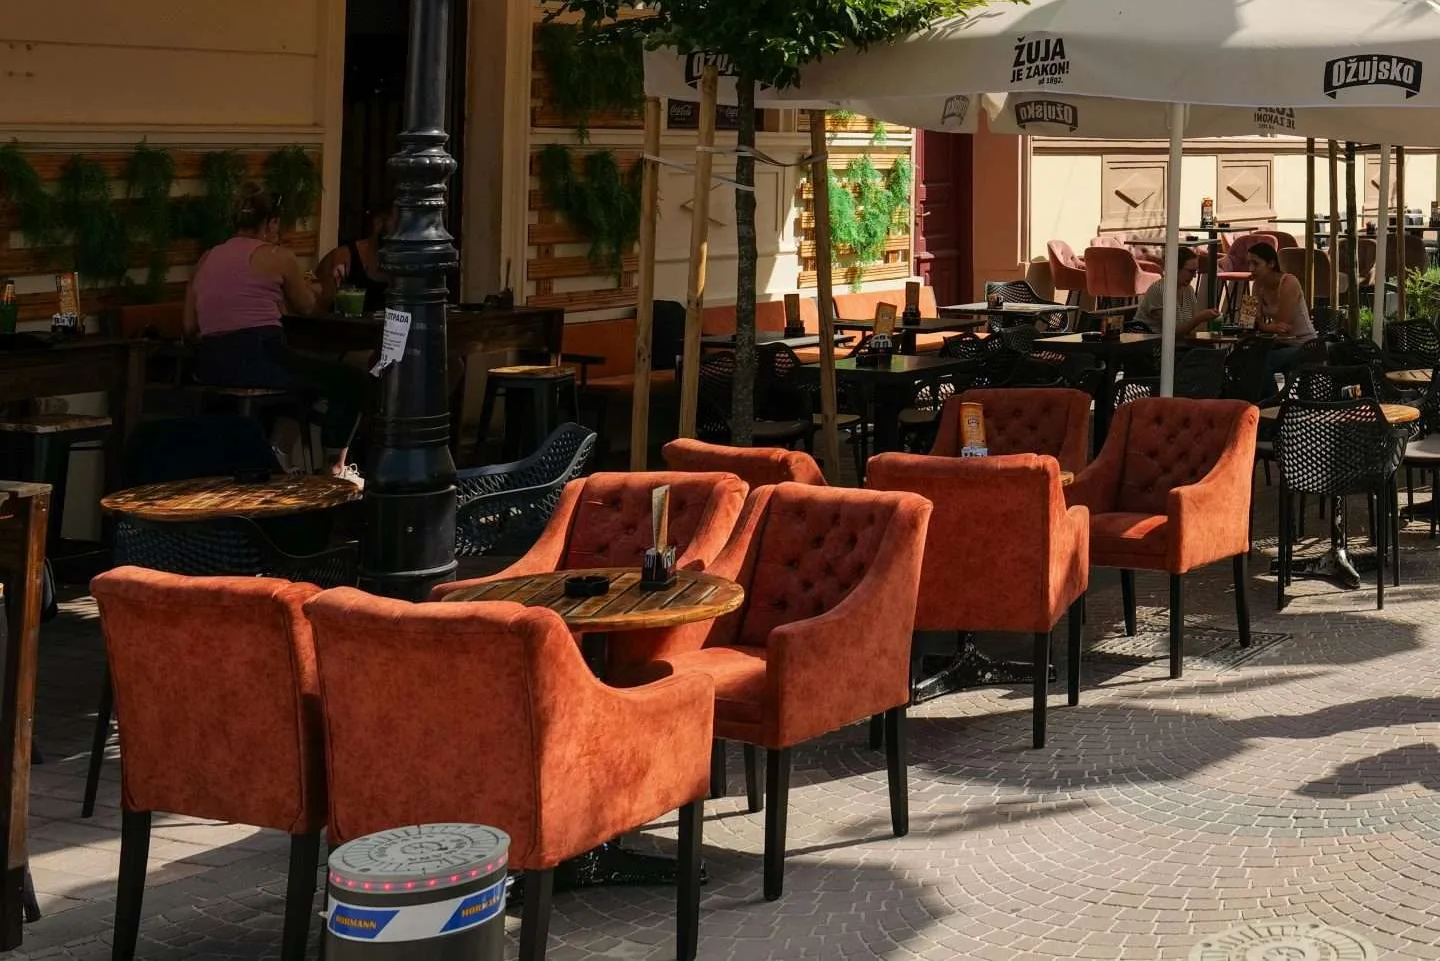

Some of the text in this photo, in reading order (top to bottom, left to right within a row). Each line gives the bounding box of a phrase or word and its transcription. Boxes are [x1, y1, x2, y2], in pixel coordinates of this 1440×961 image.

[1012, 36, 1065, 67] ŽUJA
[1010, 61, 1070, 83] JE ZAKON!
[1332, 56, 1415, 87] Ožujsko
